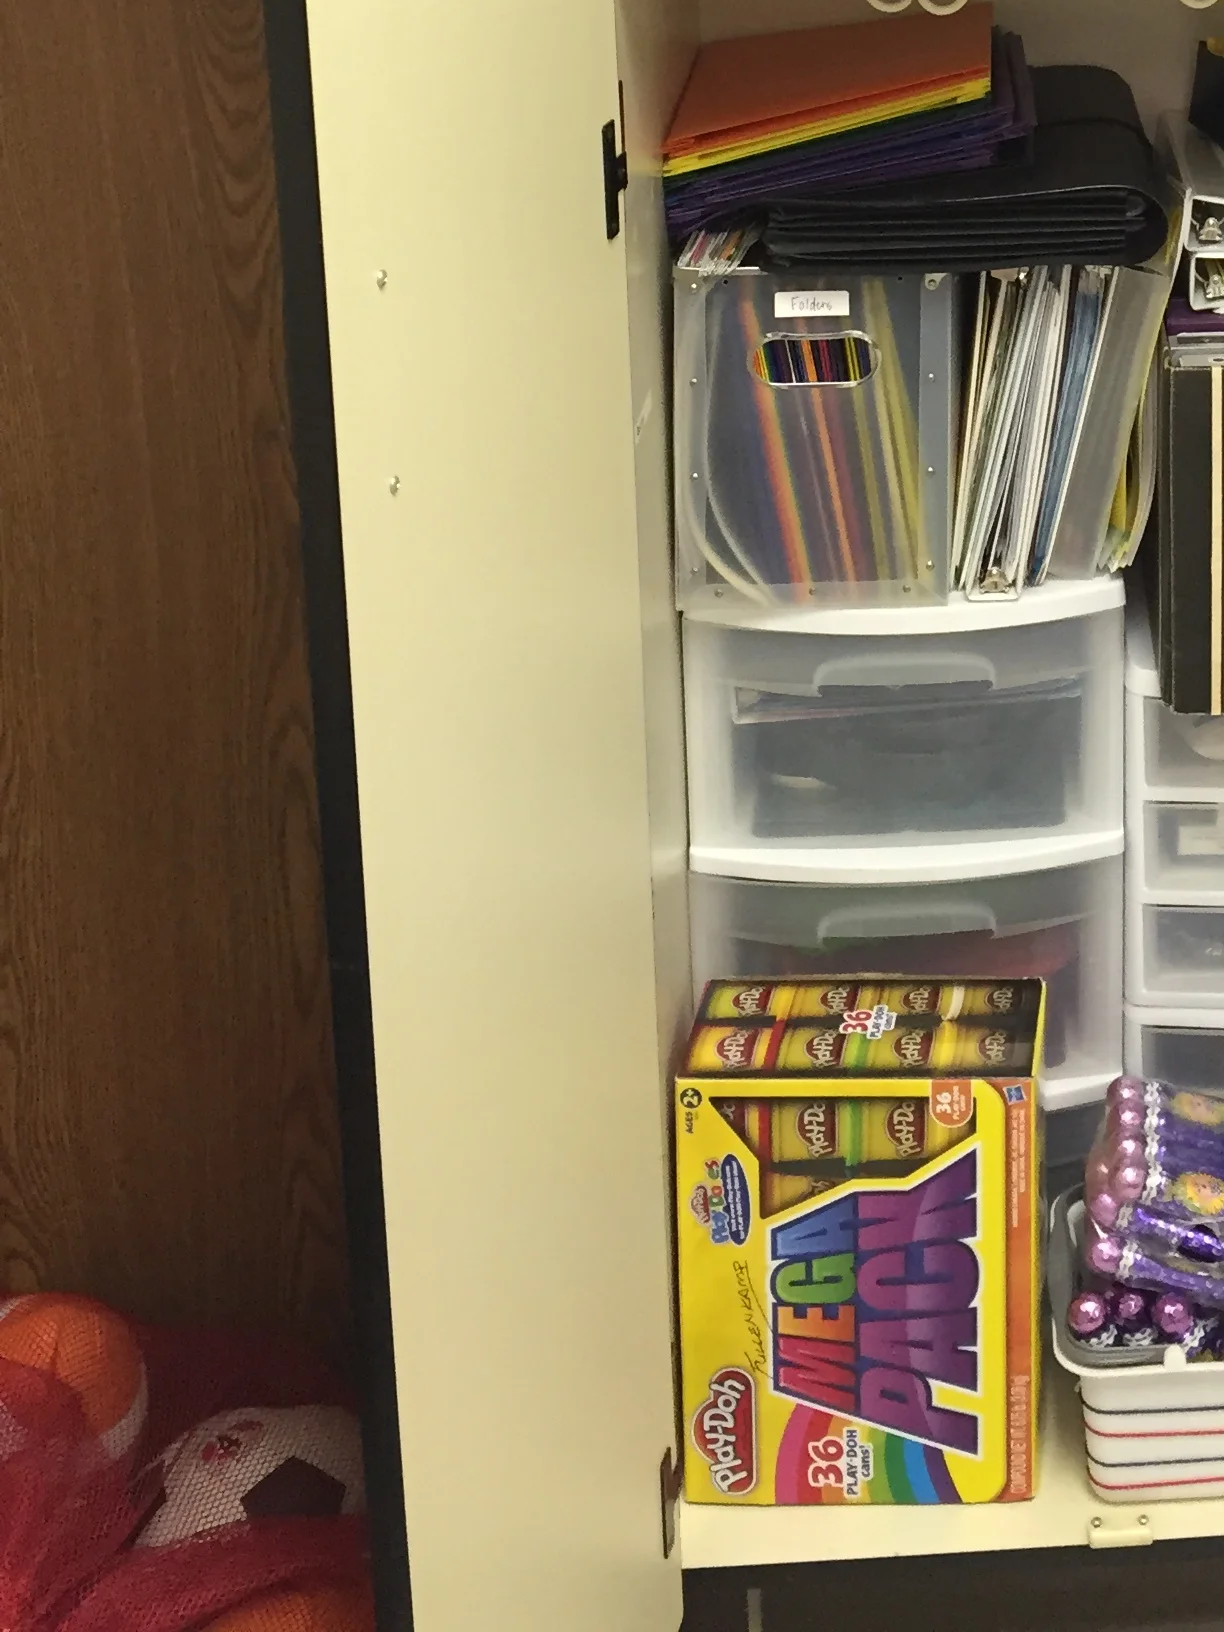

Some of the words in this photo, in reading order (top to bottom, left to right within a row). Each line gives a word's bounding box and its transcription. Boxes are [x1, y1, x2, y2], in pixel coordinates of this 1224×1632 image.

[789, 296, 833, 312] Folders
[841, 1009, 873, 1034] 36
[685, 1088, 699, 1107] 2+
[936, 1091, 951, 1114] 36
[685, 1111, 695, 1134] AGES
[775, 1190, 858, 1411] MEGA
[856, 1149, 982, 1458] PACK
[703, 1378, 748, 1493] Play-Doh
[809, 1437, 844, 1488] 36
[845, 1429, 859, 1495] PLAY-DOH
